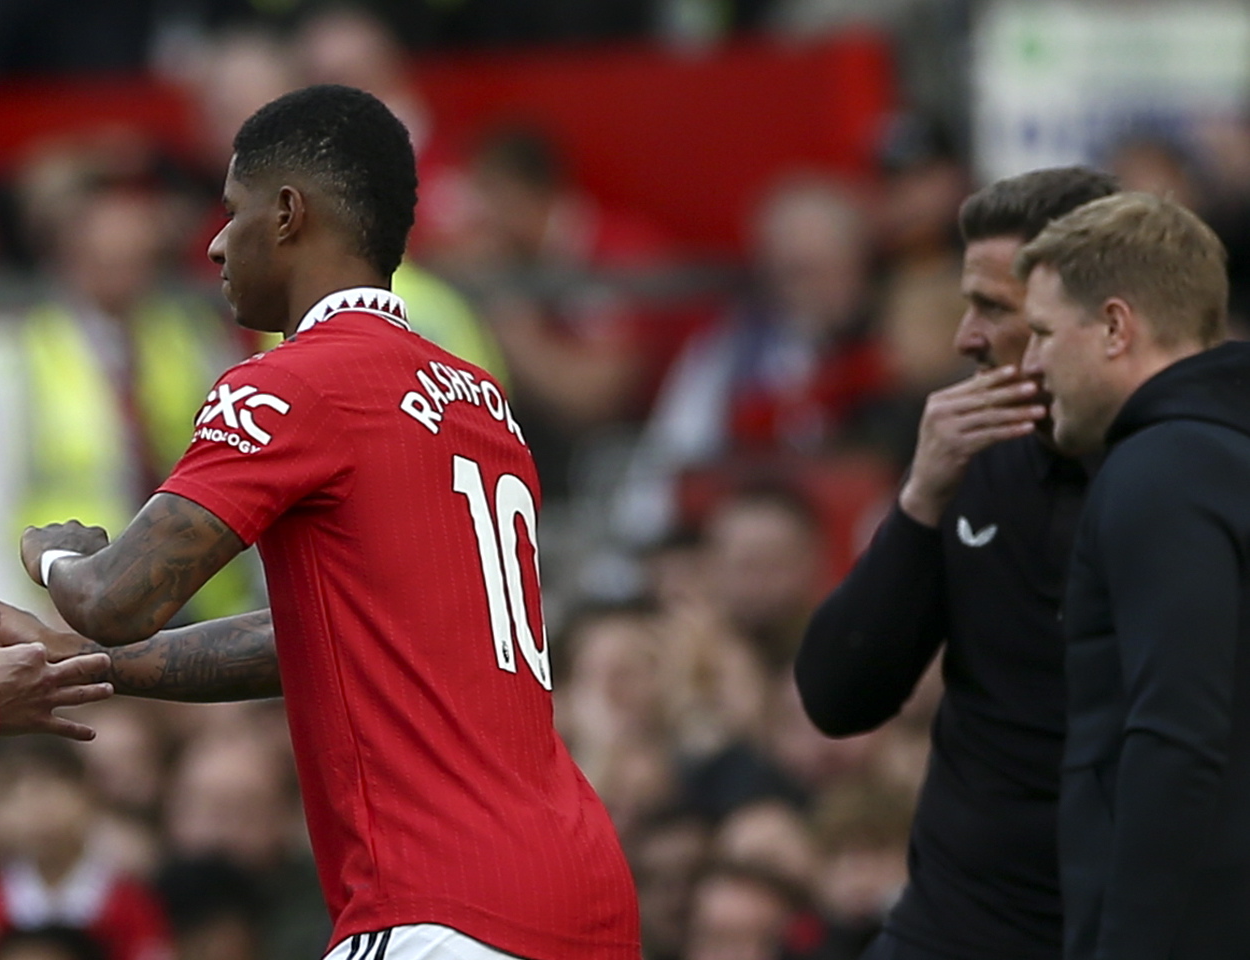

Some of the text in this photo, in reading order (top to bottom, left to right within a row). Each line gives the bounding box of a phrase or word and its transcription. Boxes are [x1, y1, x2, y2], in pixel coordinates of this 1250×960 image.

[196, 383, 291, 446] XC
[400, 361, 530, 446] RASHFOR
[453, 455, 553, 690] 10
